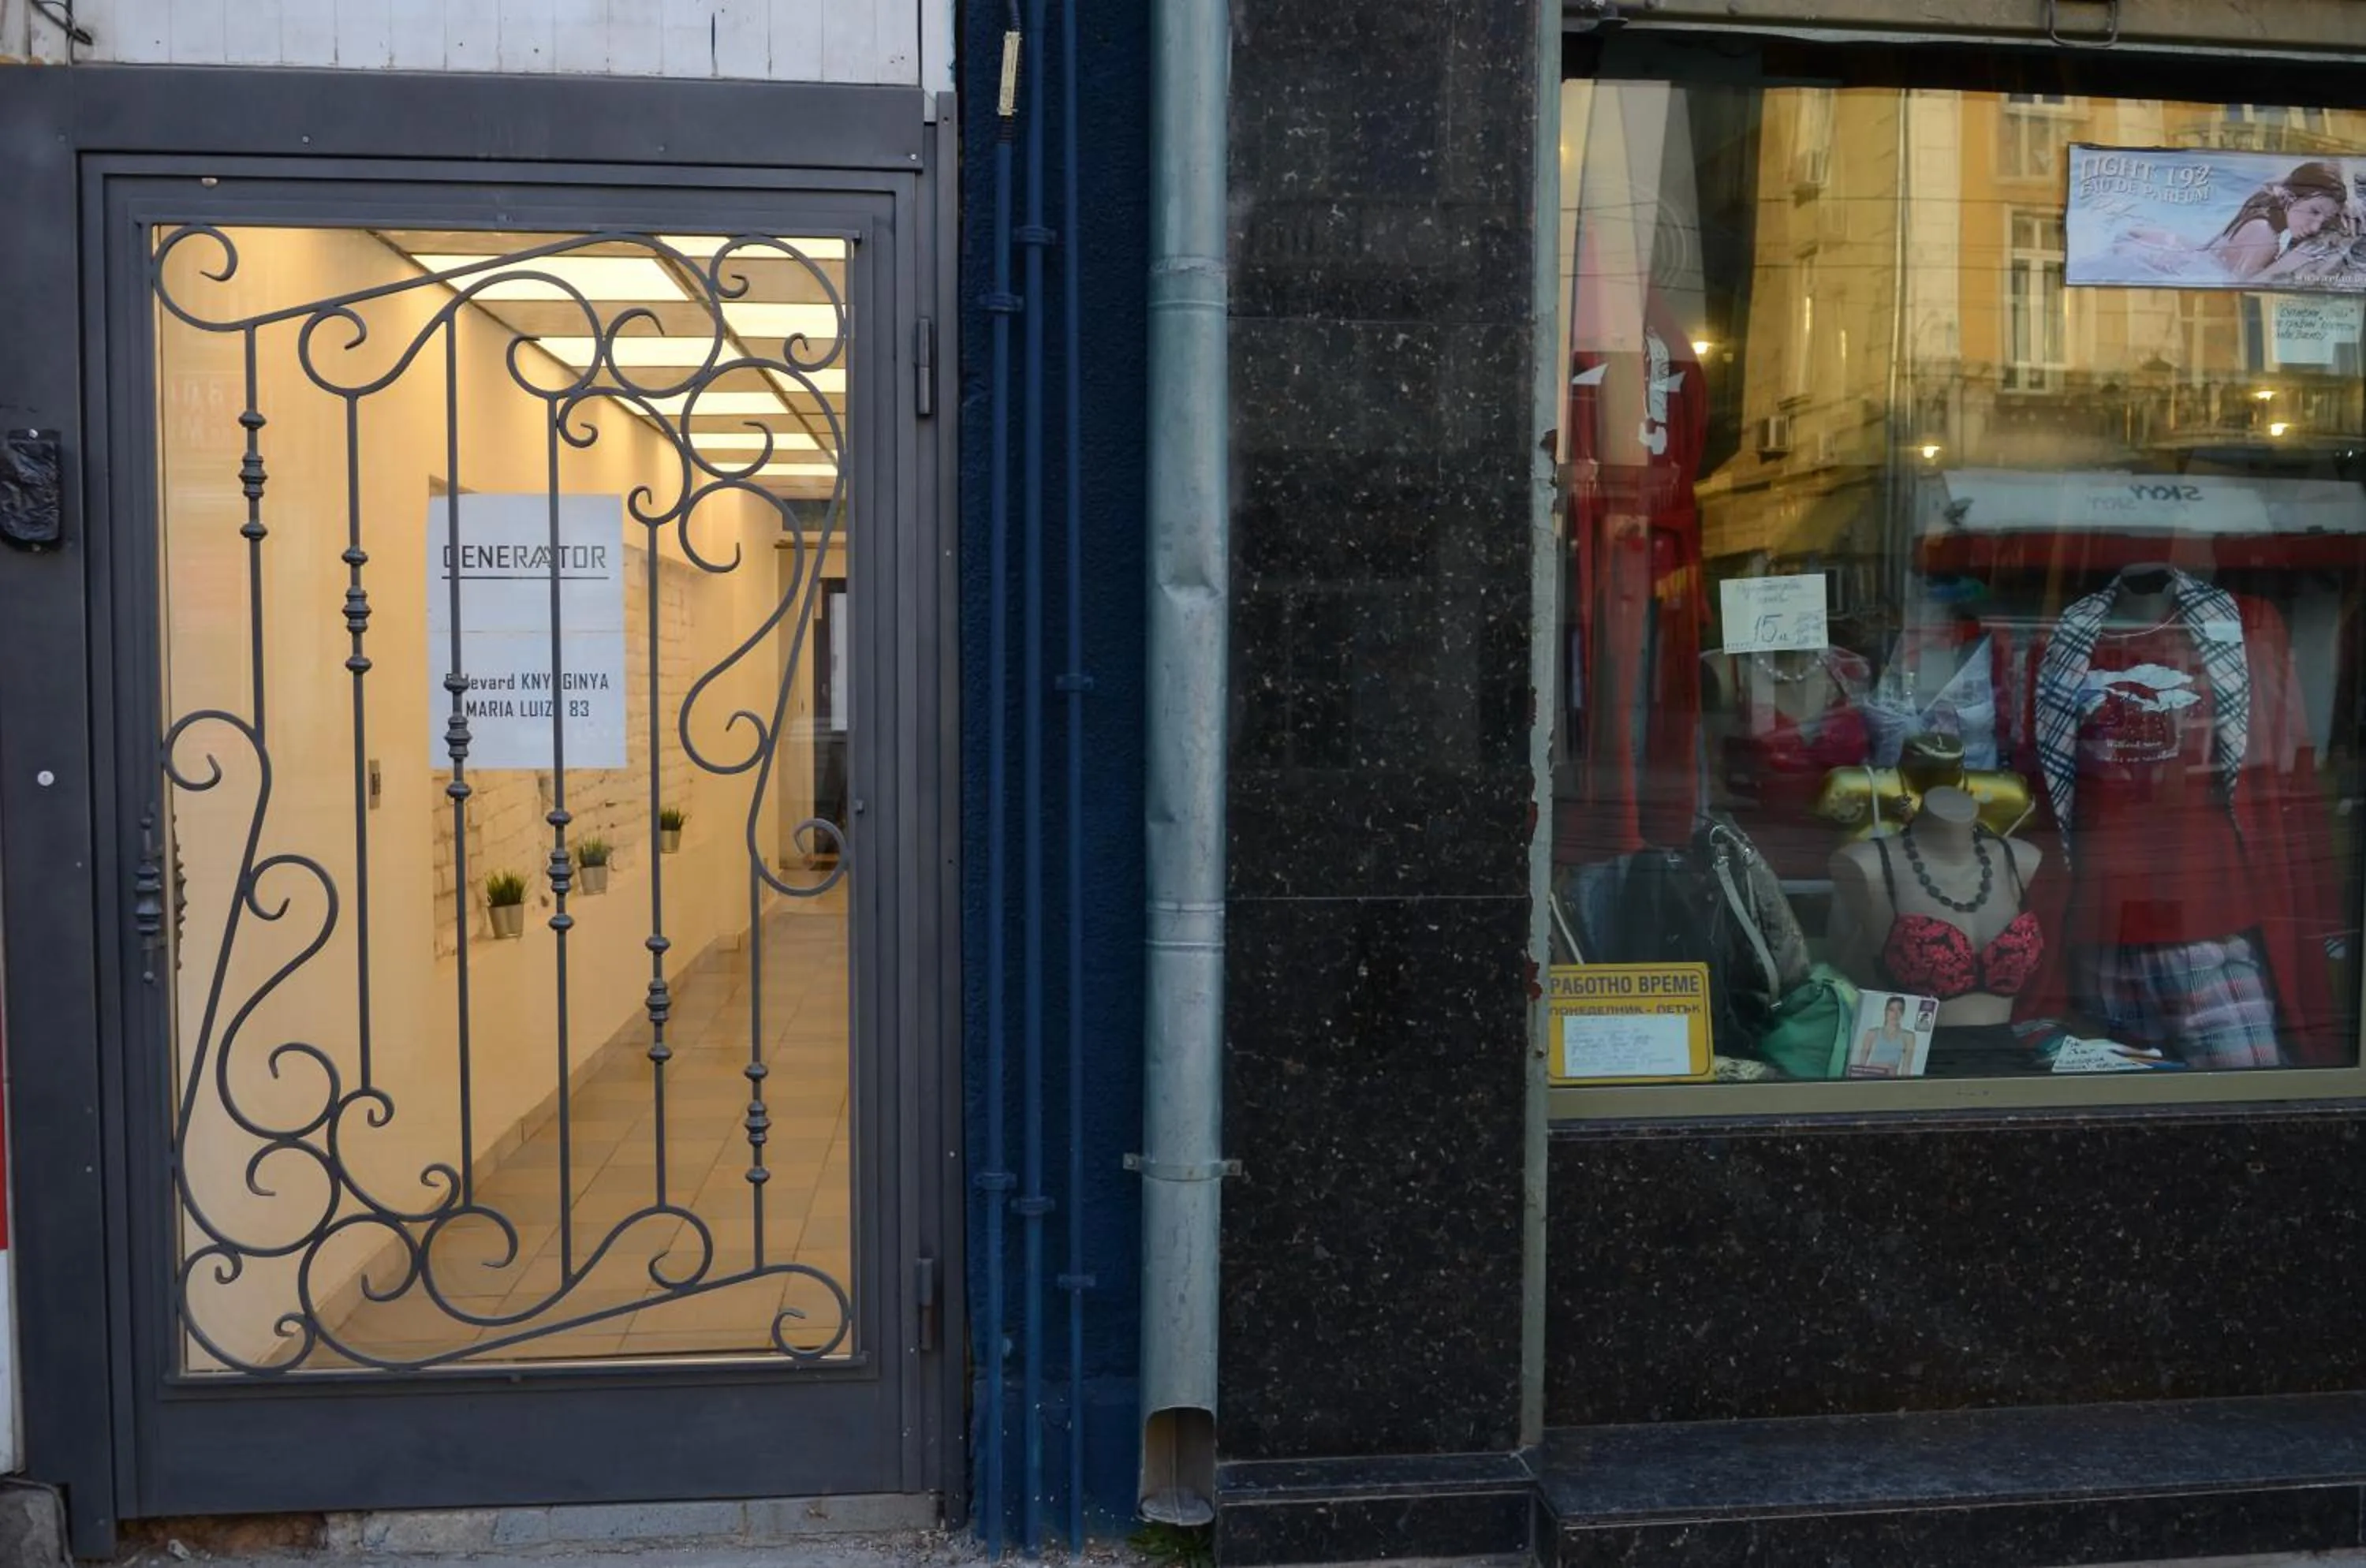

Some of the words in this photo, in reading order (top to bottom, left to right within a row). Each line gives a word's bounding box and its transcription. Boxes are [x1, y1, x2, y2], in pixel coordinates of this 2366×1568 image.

[446, 673, 515, 690] evard
[521, 673, 610, 690] KNYGINYA
[466, 700, 513, 717] MARIA
[520, 700, 558, 718] LUIZ
[569, 700, 590, 717] 83
[1550, 976, 1633, 995] РАБОТНО
[1639, 975, 1700, 994] ВРЕМЕ
